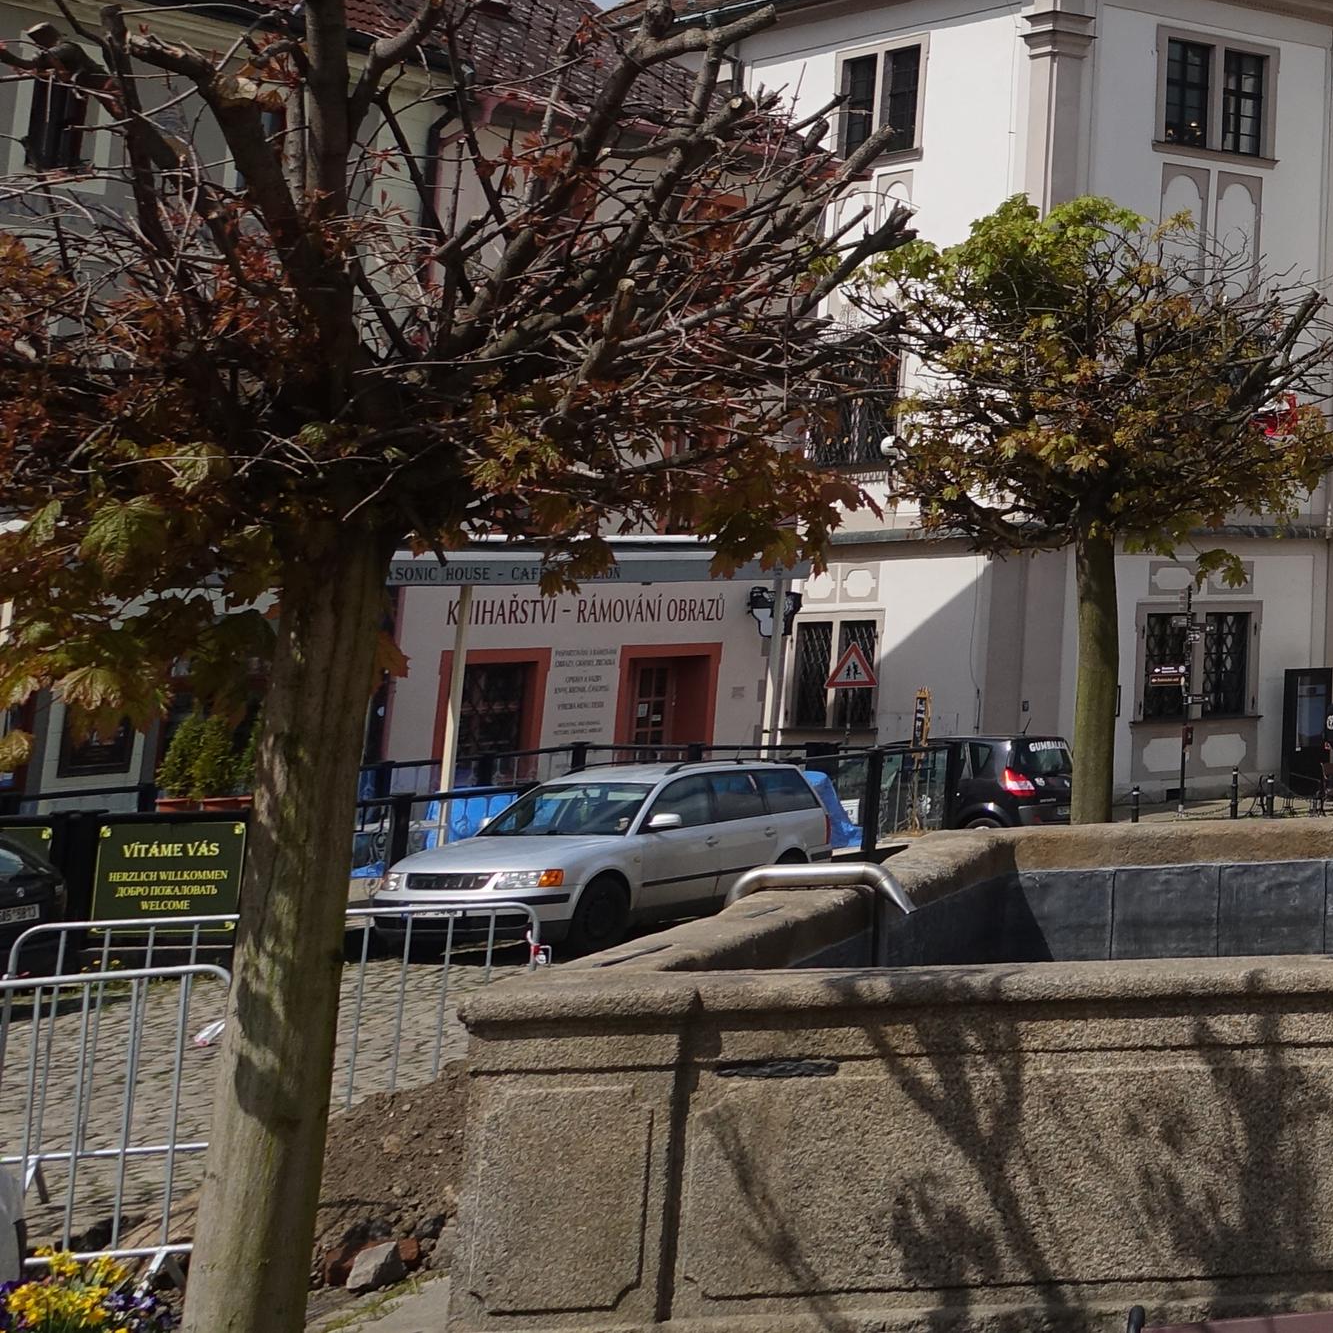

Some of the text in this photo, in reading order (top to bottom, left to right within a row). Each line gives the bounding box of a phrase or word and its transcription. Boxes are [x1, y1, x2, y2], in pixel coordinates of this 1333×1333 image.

[446, 567, 491, 581] HOUSE
[577, 593, 663, 624] RÁMOVÁNÍ
[667, 592, 725, 622] OBRAZŮ
[122, 840, 220, 858] VÍTÁME VÁS
[108, 869, 229, 882] HERZLICH WILLKOMMEN
[115, 884, 218, 898] ДОБРО ПОЖАЛОВАТЬ
[140, 900, 190, 911] WELCOME
